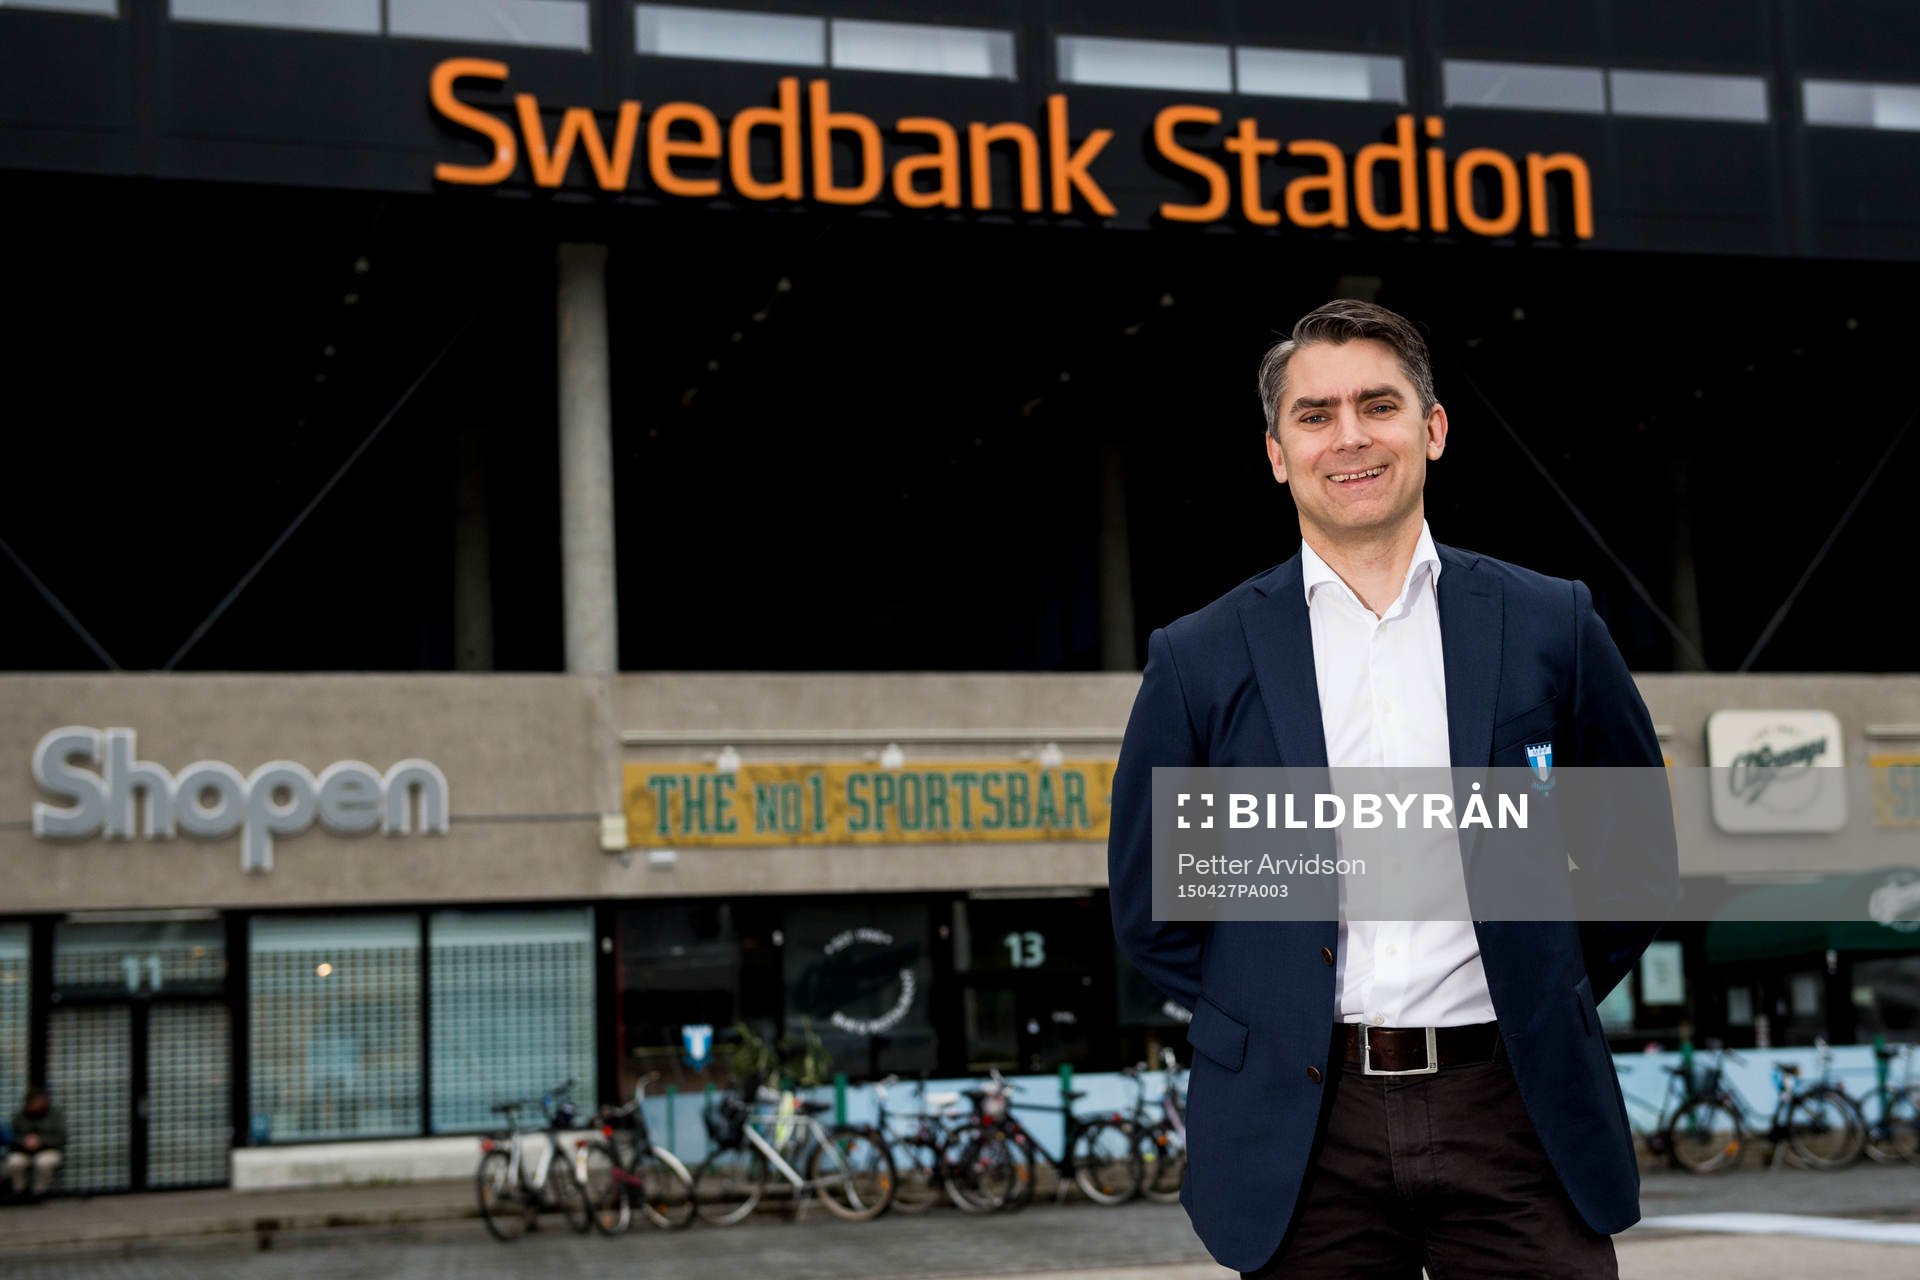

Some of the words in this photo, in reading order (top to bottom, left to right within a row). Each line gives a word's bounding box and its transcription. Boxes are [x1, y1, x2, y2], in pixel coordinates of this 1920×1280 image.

[430, 58, 1117, 217] Swedbank
[1153, 104, 1593, 239] Stadion
[31, 725, 450, 873] Shopen
[647, 774, 738, 837] THE
[846, 769, 1092, 832] SPORTSBAR
[122, 954, 163, 993] 11
[1003, 931, 1046, 969] 13
